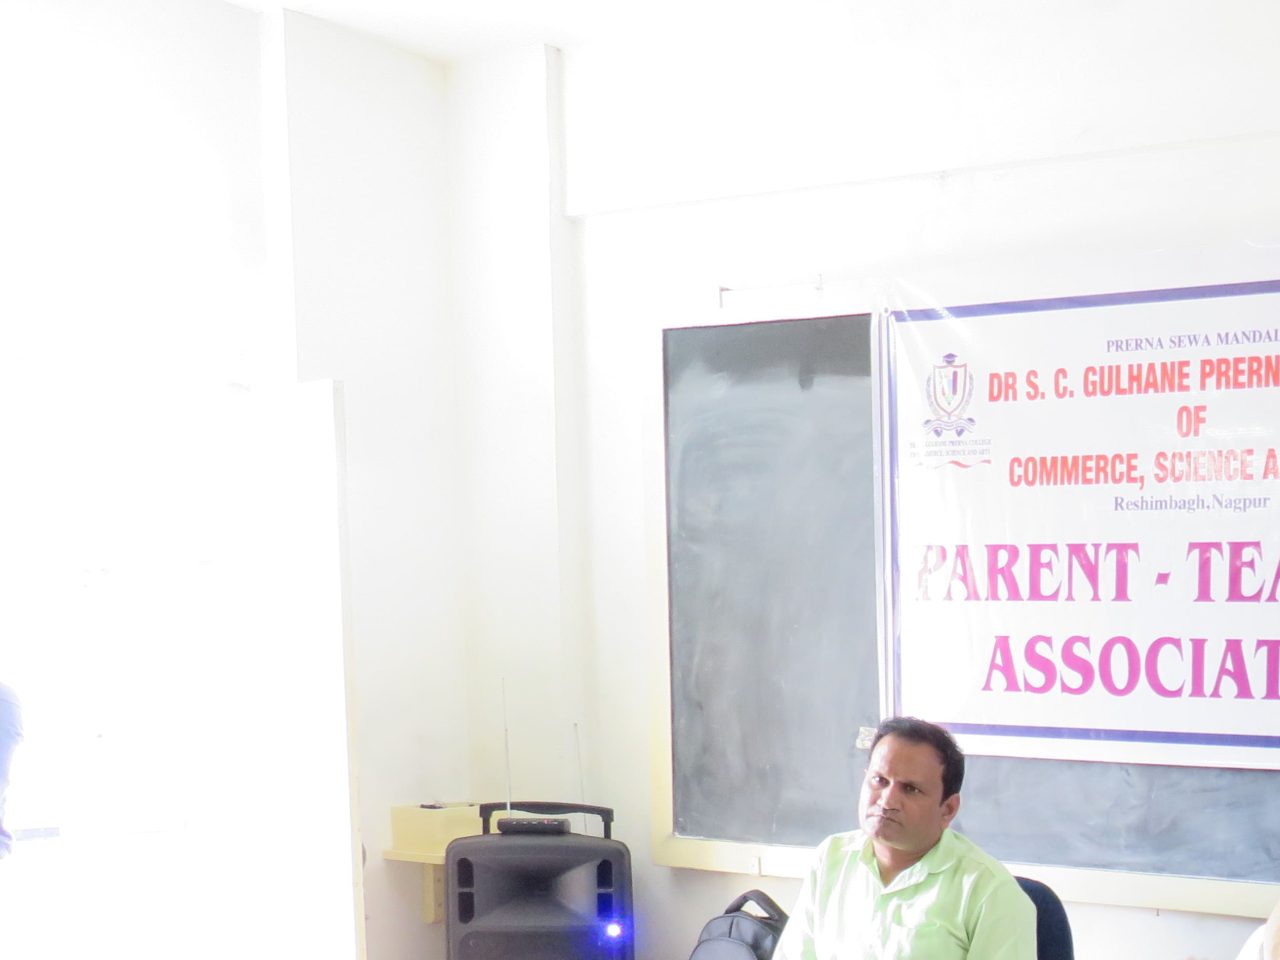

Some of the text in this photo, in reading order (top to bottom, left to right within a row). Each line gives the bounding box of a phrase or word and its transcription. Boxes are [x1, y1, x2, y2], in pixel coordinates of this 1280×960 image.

[1107, 337, 1164, 352] PRERNA
[1168, 333, 1211, 349] SEWA
[988, 371, 1018, 402] DR
[1025, 369, 1045, 401] S.
[1054, 368, 1074, 399] C.
[1083, 360, 1190, 398] GULHANE
[1177, 405, 1207, 438] OF
[1009, 453, 1145, 490] COMMERCE,
[1154, 449, 1254, 483] SCIENCE
[916, 542, 1140, 602] PARENT
